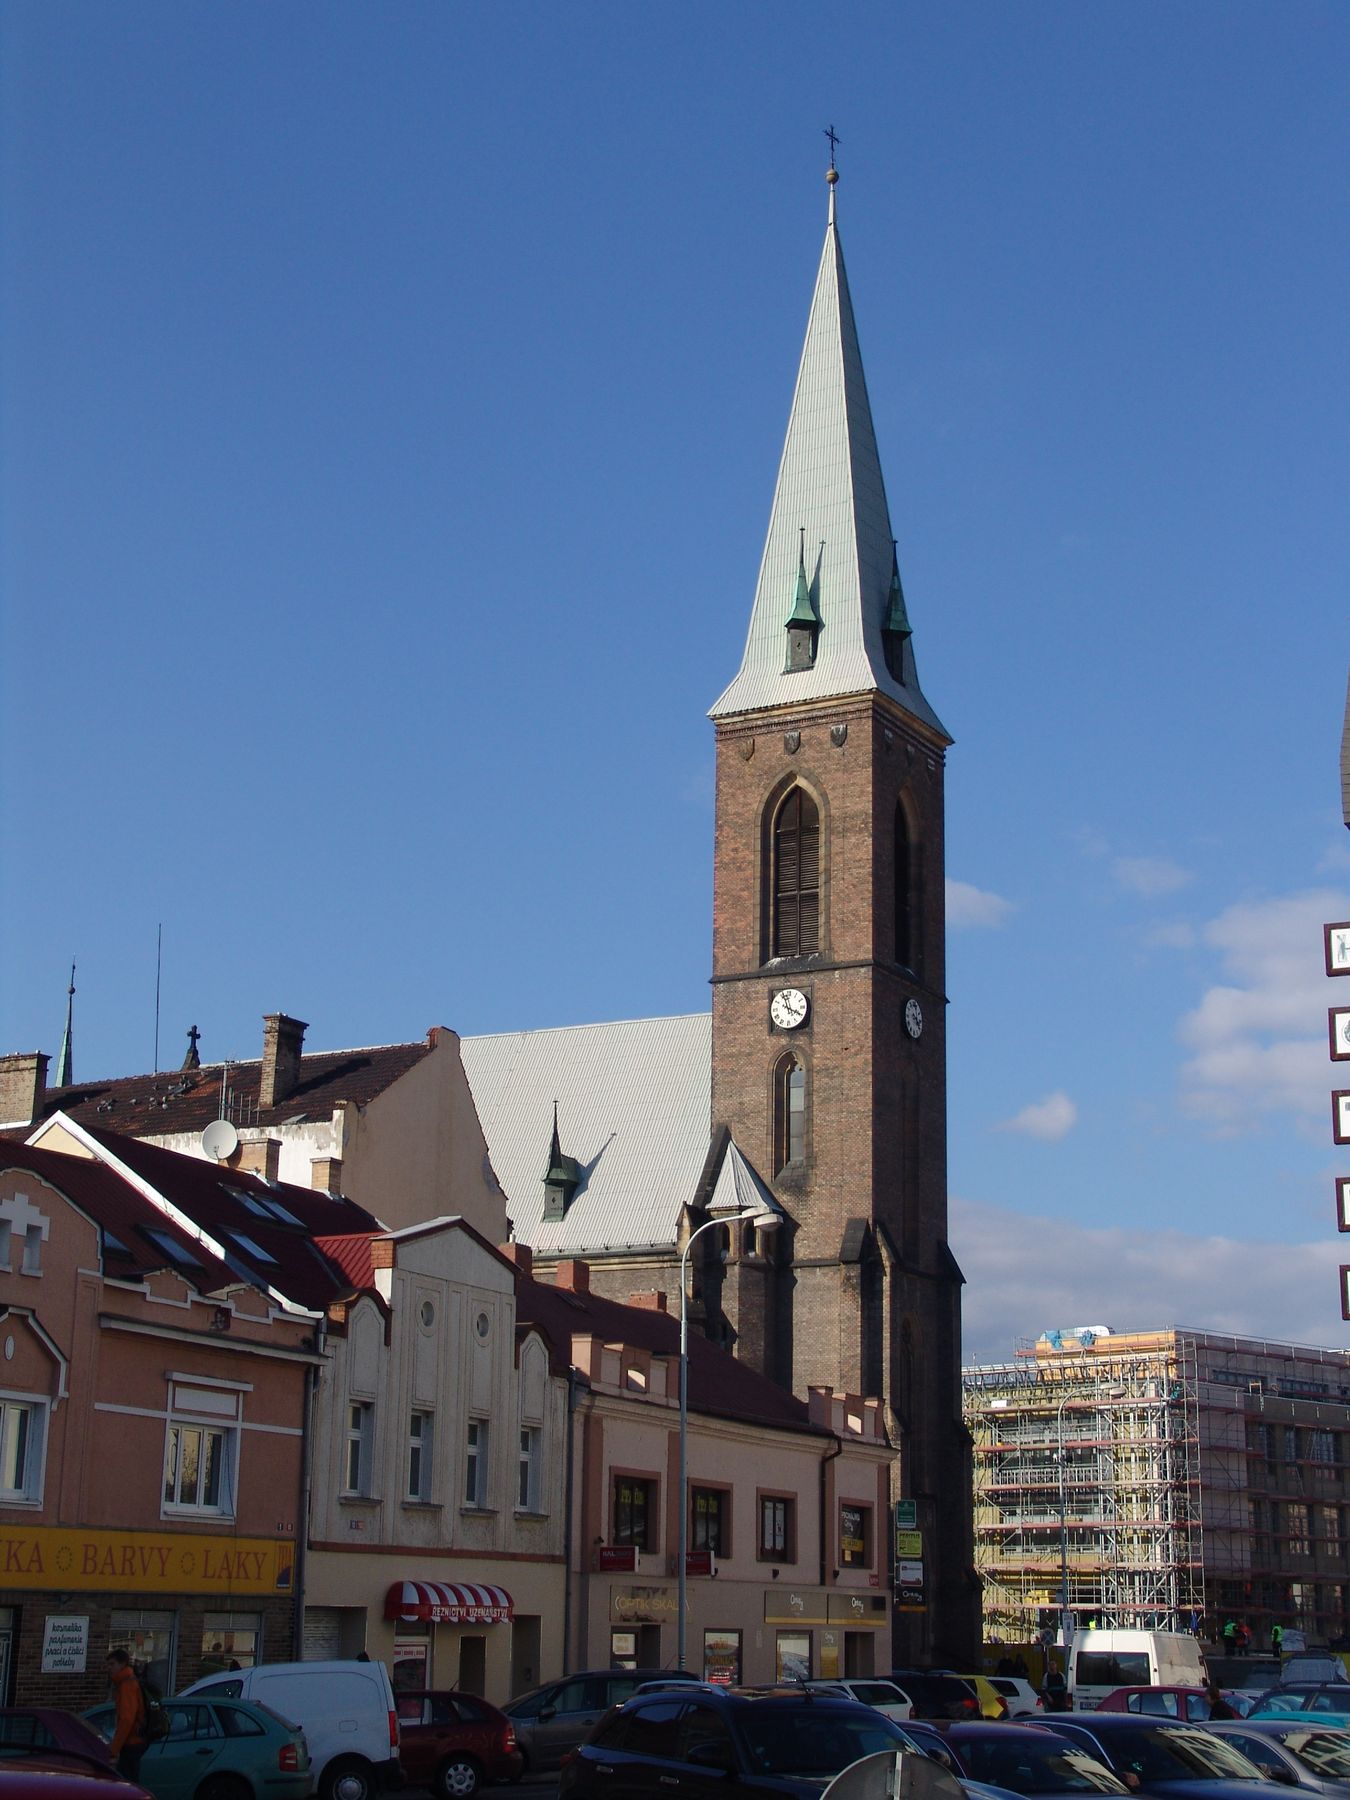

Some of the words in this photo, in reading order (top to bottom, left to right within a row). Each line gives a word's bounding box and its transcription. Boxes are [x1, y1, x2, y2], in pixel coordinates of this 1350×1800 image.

[0, 1539, 45, 1573] KA
[79, 1543, 172, 1577] BARVY
[202, 1549, 267, 1580] LAKY
